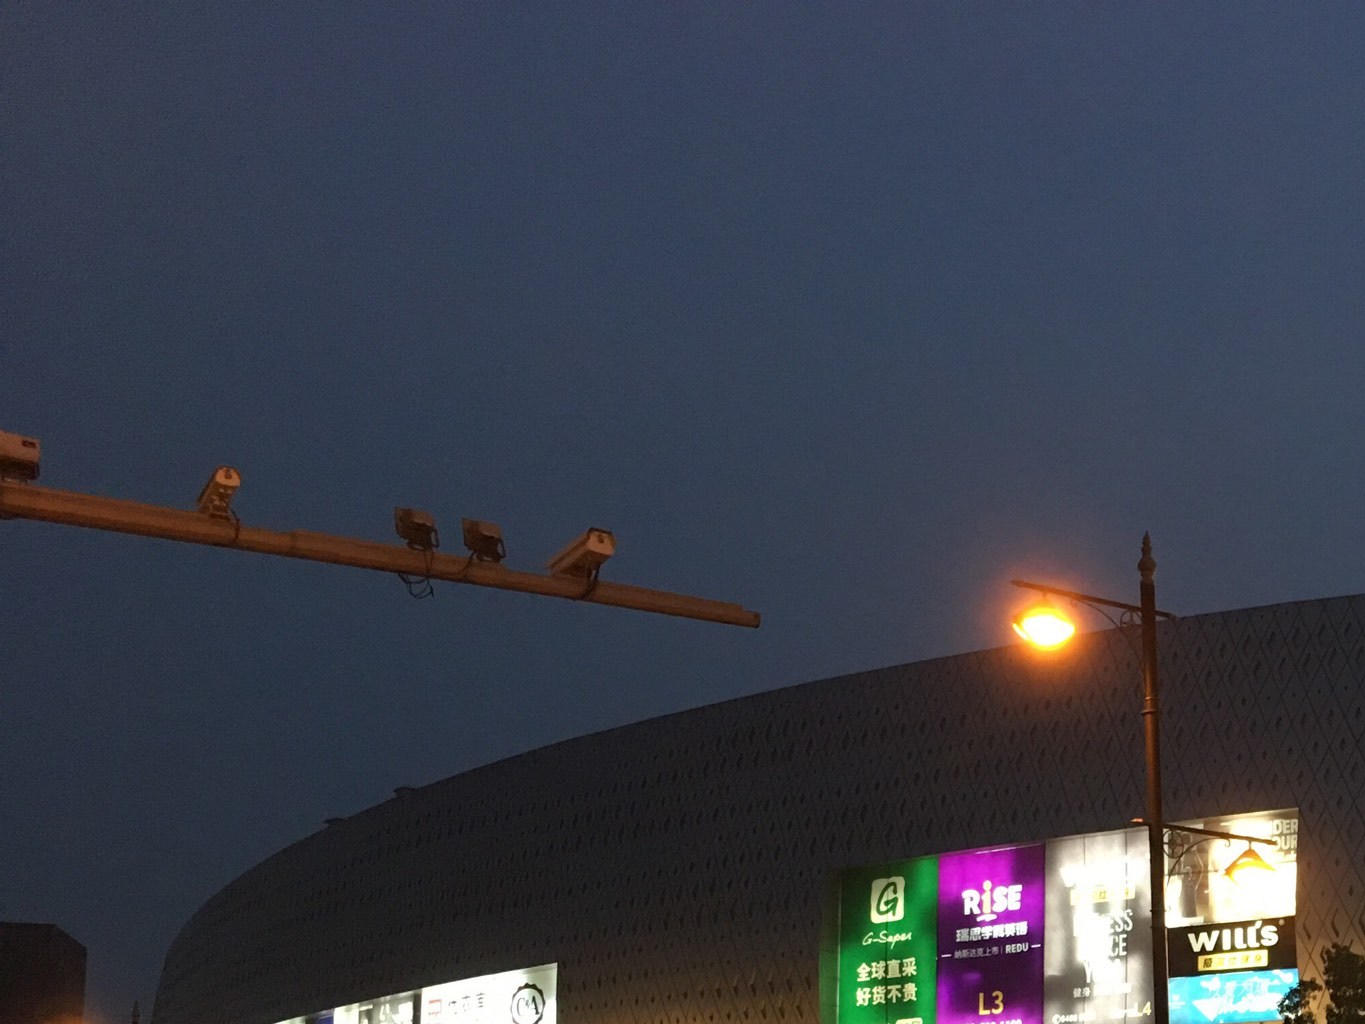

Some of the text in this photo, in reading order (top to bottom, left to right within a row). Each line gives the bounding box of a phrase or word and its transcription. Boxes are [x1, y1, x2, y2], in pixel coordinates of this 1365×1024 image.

[1005, 942, 1029, 954] REDU
[856, 957, 917, 982] 全球直采
[855, 982, 917, 1007] 好货不贵
[978, 990, 1005, 1016] L3
